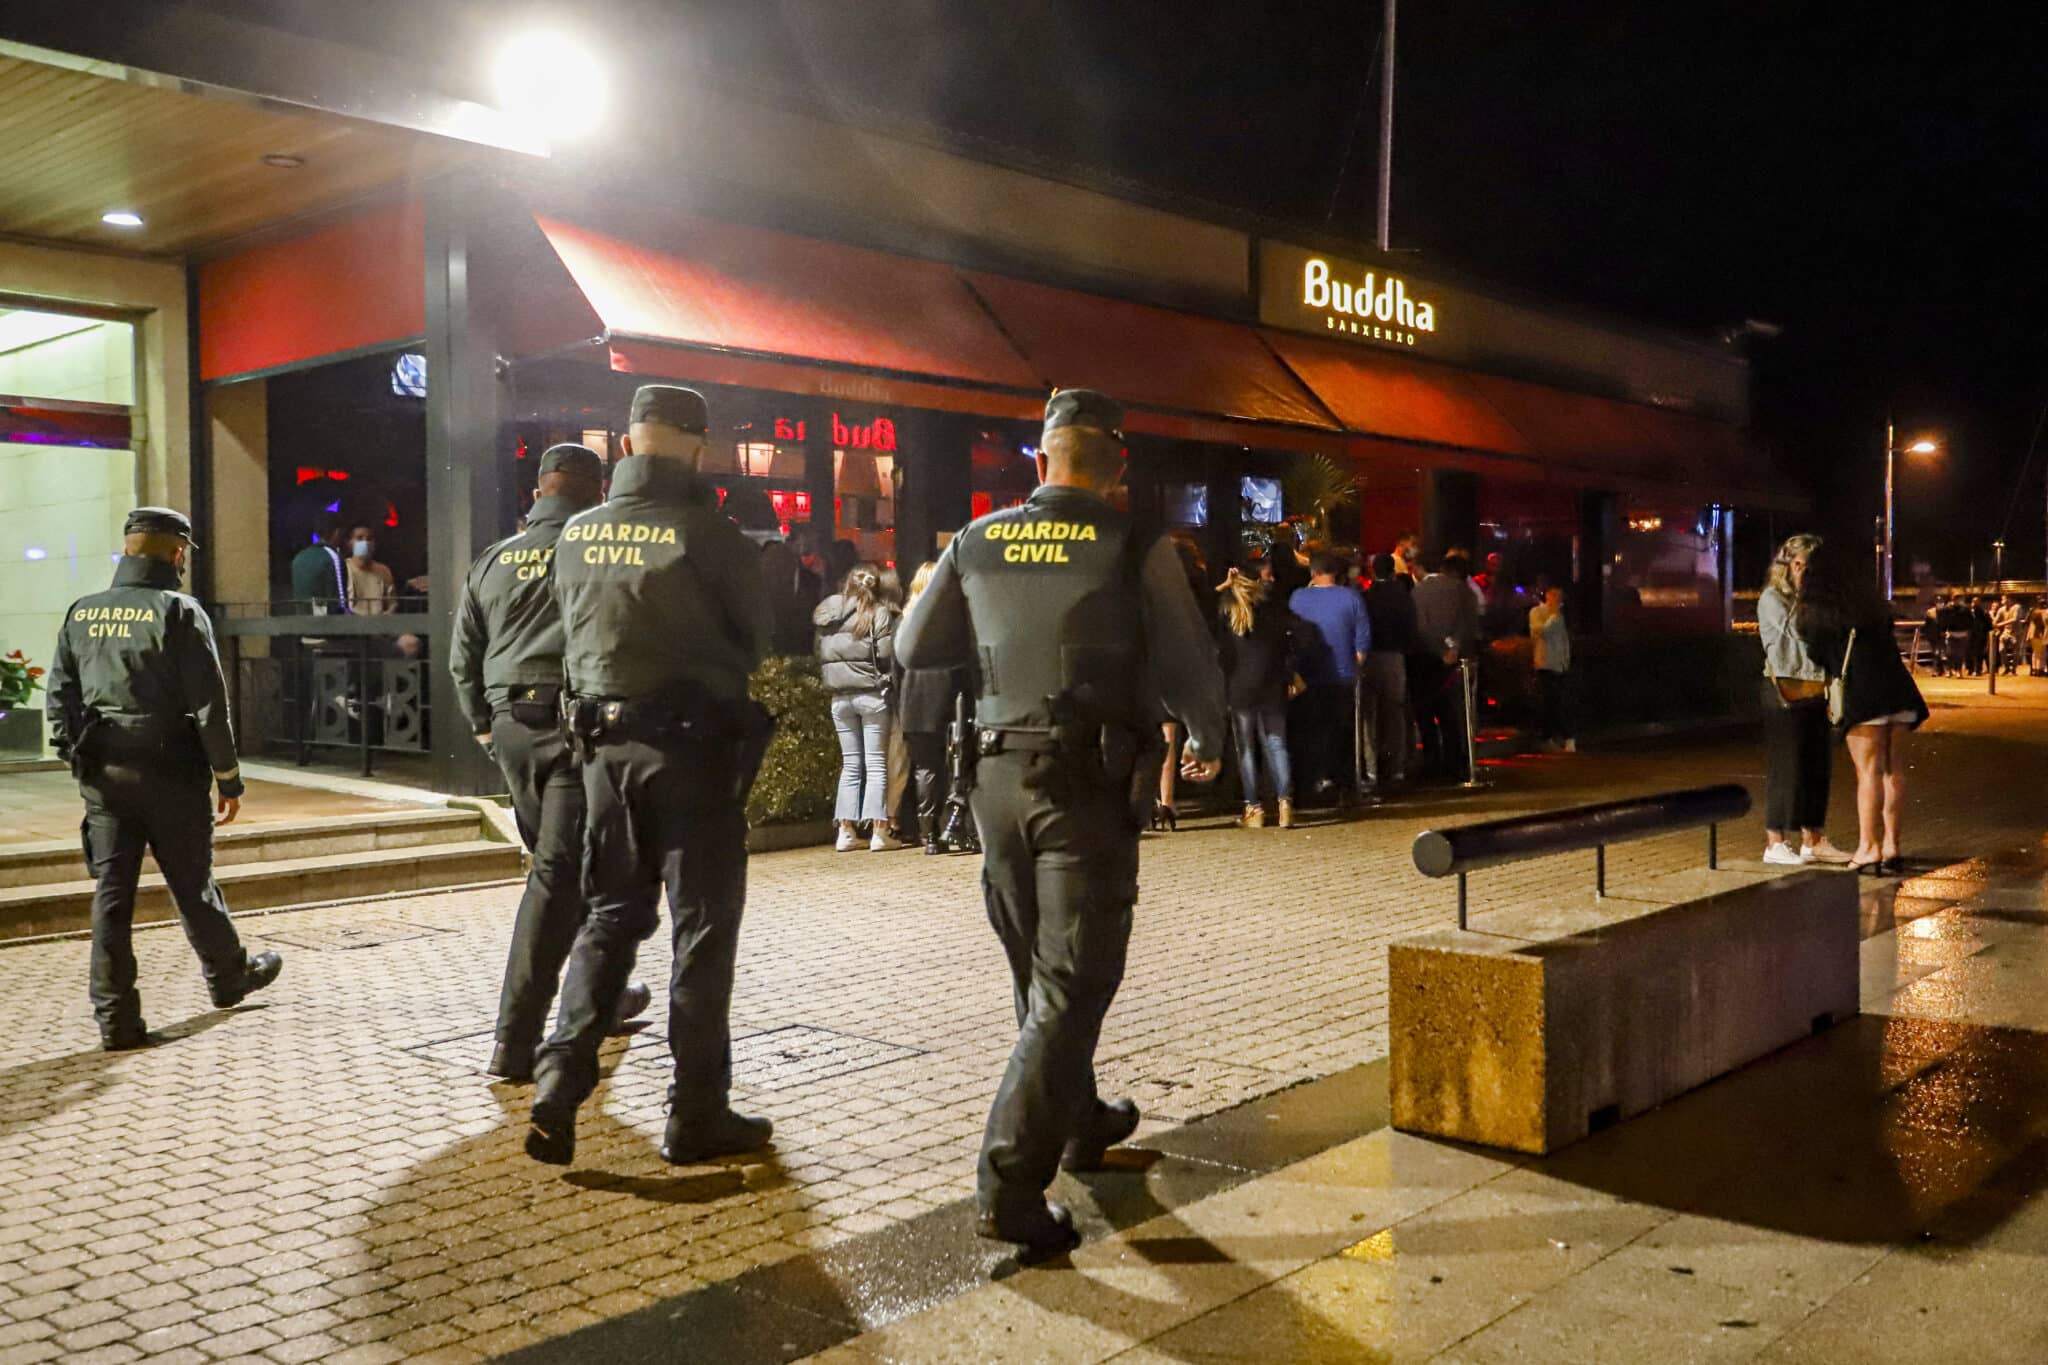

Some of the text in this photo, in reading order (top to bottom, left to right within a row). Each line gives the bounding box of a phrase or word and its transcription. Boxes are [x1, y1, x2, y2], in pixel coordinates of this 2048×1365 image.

[1303, 259, 1434, 332] Buddha
[1327, 316, 1415, 346] SANXENXO
[565, 523, 677, 545] GUARDIA
[984, 522, 1097, 541] GUARDIA
[583, 546, 645, 566] CIVIL
[1004, 543, 1069, 563] CIVIL
[74, 607, 154, 623] GUARDIA
[88, 623, 132, 638] CIVIL
